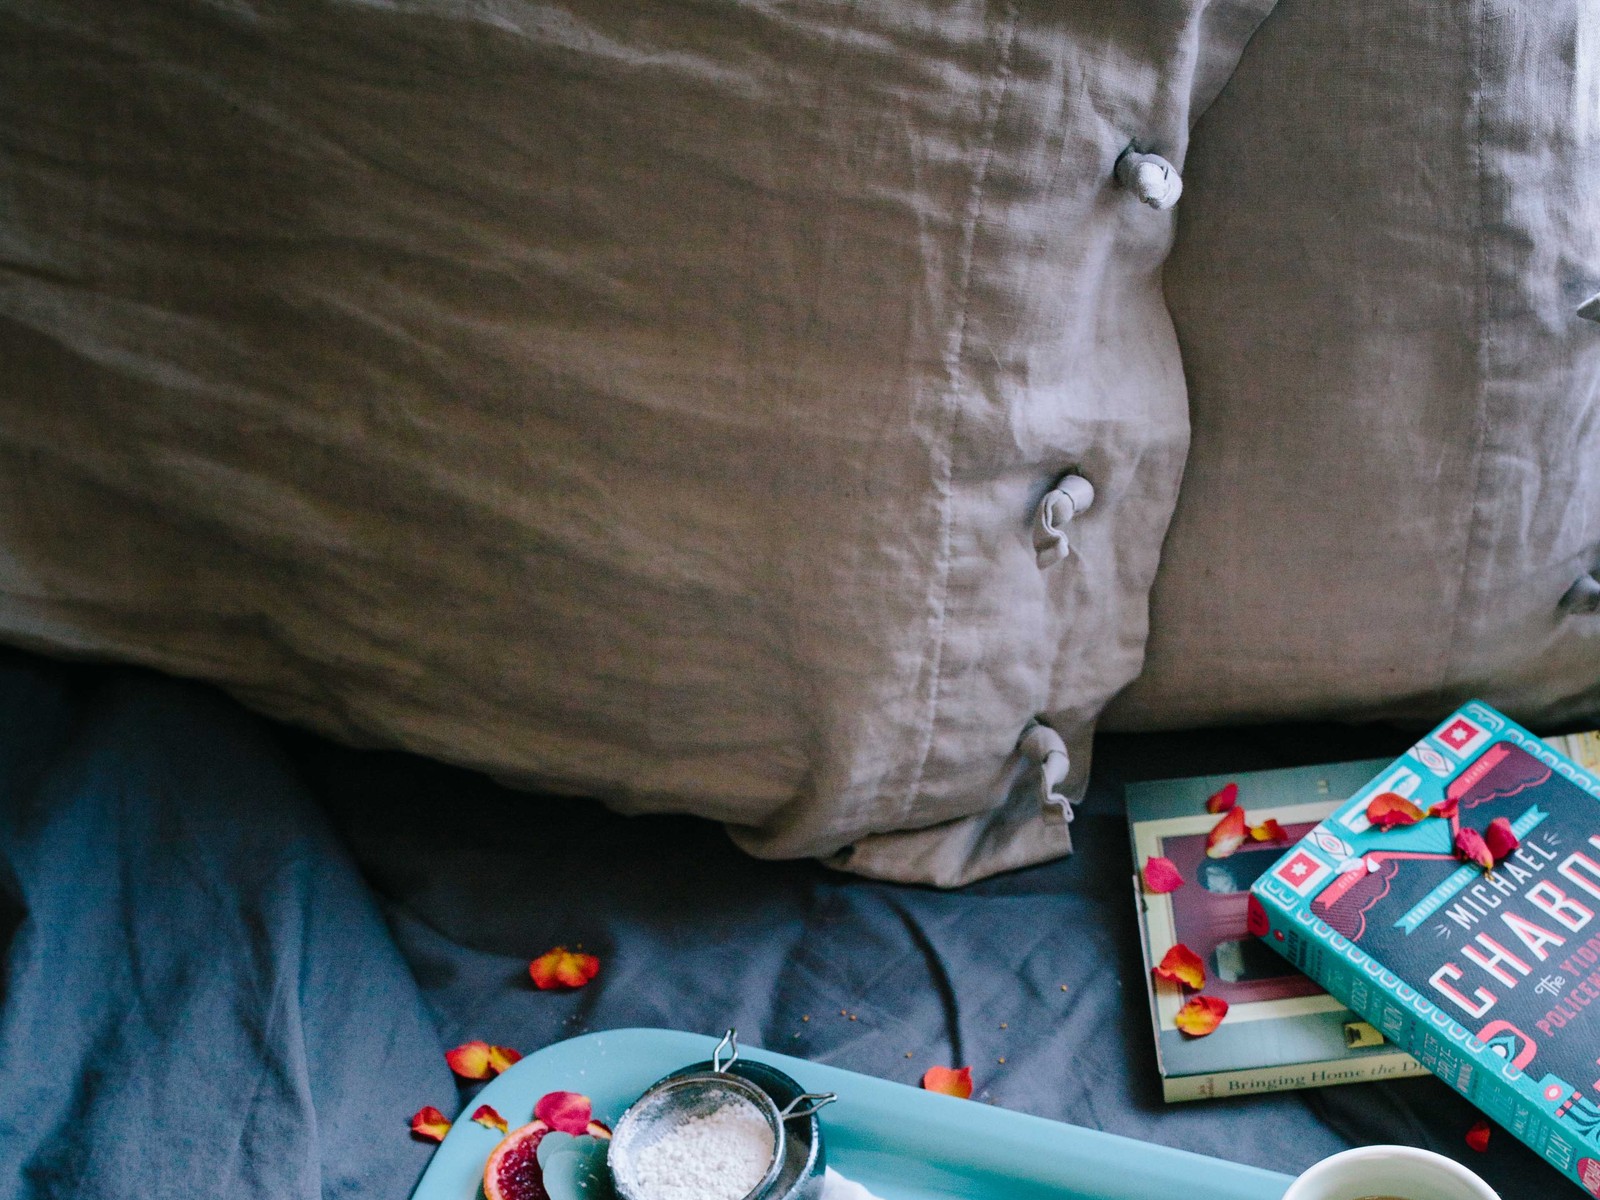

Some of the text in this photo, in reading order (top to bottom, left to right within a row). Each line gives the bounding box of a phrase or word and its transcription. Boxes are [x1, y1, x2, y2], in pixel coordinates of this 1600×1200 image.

[1444, 841, 1557, 931] MICHAEL
[1428, 834, 1600, 1019] CHABO
[1534, 932, 1600, 997] The YIDD
[1229, 1074, 1306, 1092] Bringing
[1312, 1068, 1364, 1083] Home
[1371, 1063, 1396, 1076] the
[1545, 1130, 1573, 1170] CLAY
